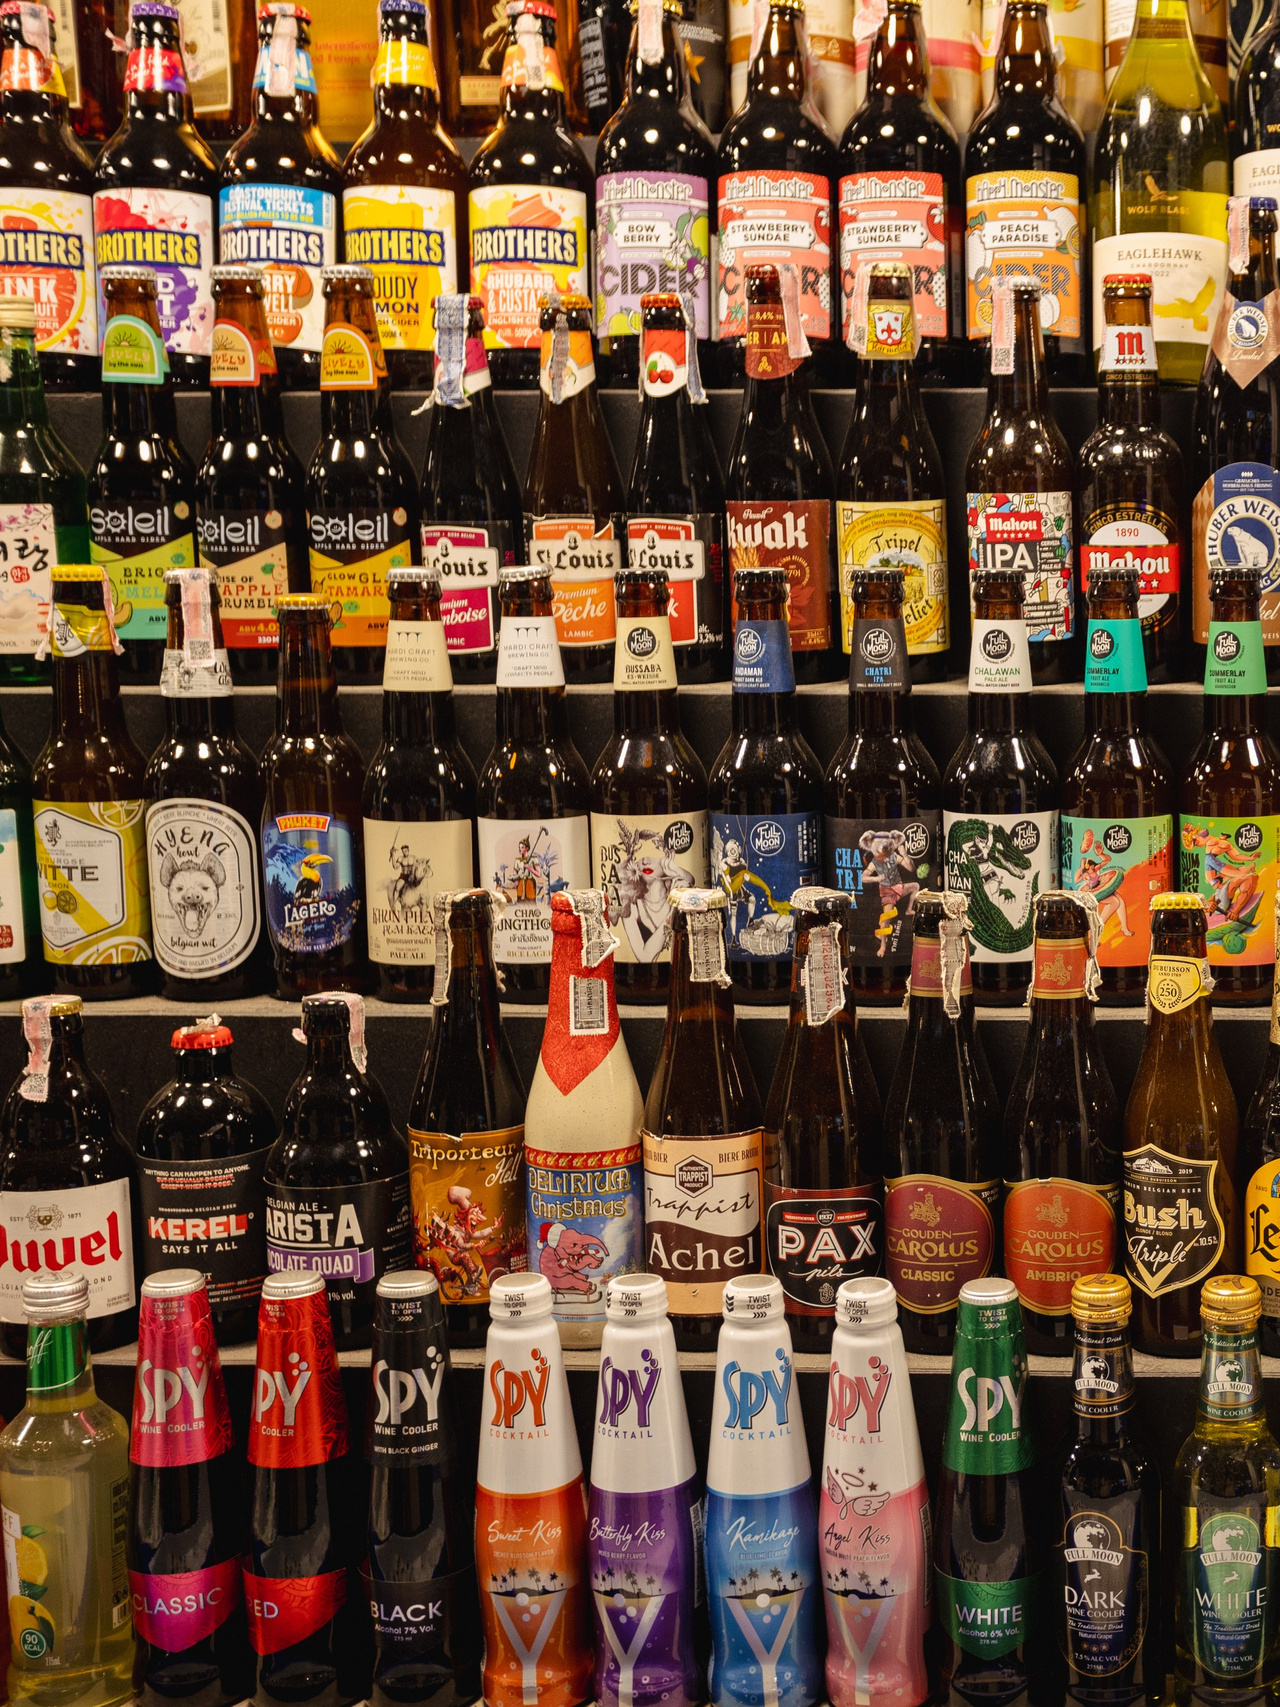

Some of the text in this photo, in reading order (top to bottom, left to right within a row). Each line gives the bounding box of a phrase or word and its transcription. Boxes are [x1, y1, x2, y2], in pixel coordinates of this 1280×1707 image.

[229, 189, 305, 202] GLASTONBURY
[224, 200, 314, 214] FESTIVAL TICKETS
[628, 225, 655, 233] BOW
[731, 224, 806, 235] STRAWBERRY
[846, 224, 917, 236] STRAWBERRY
[1000, 224, 1039, 233] PEACH
[623, 234, 660, 243] BERRY
[743, 233, 790, 242] SUNDAE
[857, 233, 901, 243] SUNDAE
[991, 233, 1049, 243] PARADISE
[96, 230, 199, 265] BROTHERS
[221, 231, 323, 264] BROTHERS
[345, 231, 444, 264] BROTHERS
[473, 229, 577, 263] BROTHERS
[1117, 249, 1203, 261] EAGLEHAWK
[487, 272, 554, 289] RHUBARB
[989, 517, 1038, 531] Mahou
[1089, 512, 1168, 535] CINCO ESTRELLAS
[1208, 505, 1242, 556] HUBER
[1115, 528, 1140, 538] 1890
[870, 533, 922, 557] Tripel
[638, 552, 694, 570] Louis
[987, 545, 1035, 570] IPA
[1088, 552, 1170, 575] Mahou
[554, 587, 597, 602] Premium
[551, 600, 608, 622] Pêche
[564, 629, 594, 637] LAMBIC
[529, 643, 554, 651] CRAFT
[625, 664, 662, 673] BUSSABA
[865, 667, 893, 677] CHATRI
[974, 667, 1021, 676] CHALAWAN
[1086, 667, 1120, 676] SUMMERLAY
[1209, 669, 1246, 677] SUMMERLAY
[280, 816, 329, 832] PHUKET
[154, 825, 231, 857] HYENA
[176, 846, 199, 858] howl
[949, 852, 968, 865] CHA
[949, 877, 971, 889] WAN
[1159, 987, 1178, 998] 250
[678, 1171, 708, 1183] TRAPPIST
[531, 1197, 626, 1220] Christmas
[647, 1187, 754, 1220] Trappist
[1124, 1200, 1207, 1230] Bush
[149, 1215, 247, 1241] KEREL
[902, 1230, 952, 1239] GOUDEN
[1027, 1230, 1077, 1239] GOUDEN
[162, 1241, 238, 1254] SAYS IT ALL
[778, 1222, 877, 1262] PAX
[887, 1236, 979, 1257] CAROLUS
[1009, 1237, 1104, 1257] CAROLUS
[648, 1236, 754, 1273] Achel
[1128, 1235, 1187, 1266] Triple
[901, 1269, 955, 1282] CLASSIC
[138, 1358, 211, 1423] SPY
[374, 1358, 445, 1425] SPY
[490, 1358, 551, 1427] SPY
[599, 1356, 662, 1427] SPY
[723, 1360, 793, 1427] SPY
[828, 1360, 892, 1433] SPY
[957, 1367, 1026, 1432] SPY
[490, 1429, 550, 1441] COCKTAIL
[598, 1426, 653, 1438] COCKTAIL
[722, 1426, 792, 1441] COCKTAIL
[827, 1427, 884, 1444] COCKTAIL
[1065, 1549, 1124, 1565] FULL MOON
[133, 1587, 223, 1616] CLASSIC
[1064, 1586, 1125, 1609] DARK
[1195, 1587, 1267, 1608] WHITE
[370, 1600, 443, 1622] BLACK
[956, 1604, 1022, 1625] WHITE
[25, 1633, 39, 1644] 90
[24, 1643, 42, 1652] KCAL
